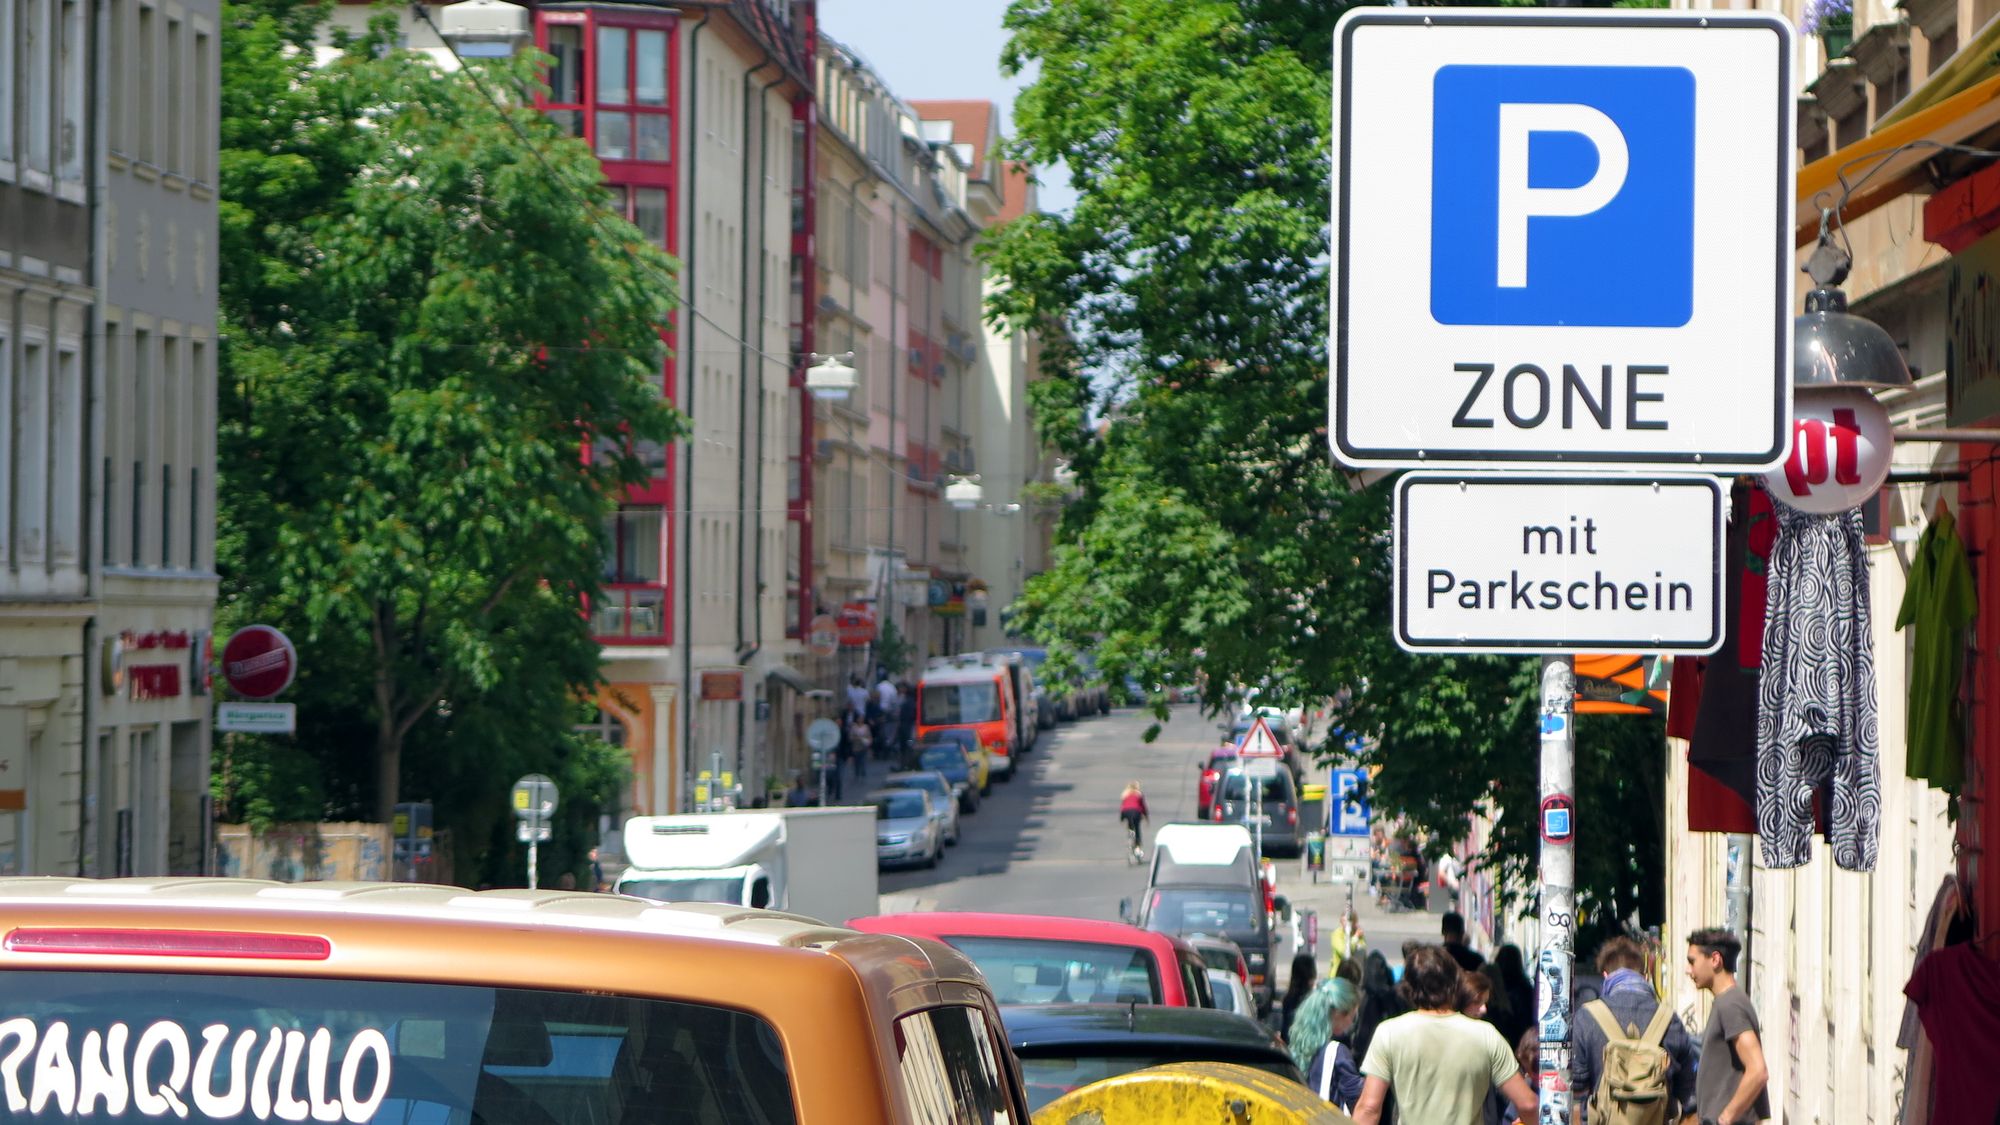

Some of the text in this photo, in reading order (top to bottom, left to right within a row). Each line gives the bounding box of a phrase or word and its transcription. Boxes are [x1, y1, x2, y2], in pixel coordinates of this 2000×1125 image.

[1497, 103, 1630, 288] P
[1451, 363, 1669, 431] ZONE
[1784, 408, 1862, 496] pt
[1523, 515, 1597, 555] mit
[1427, 569, 1692, 612] Parkschein
